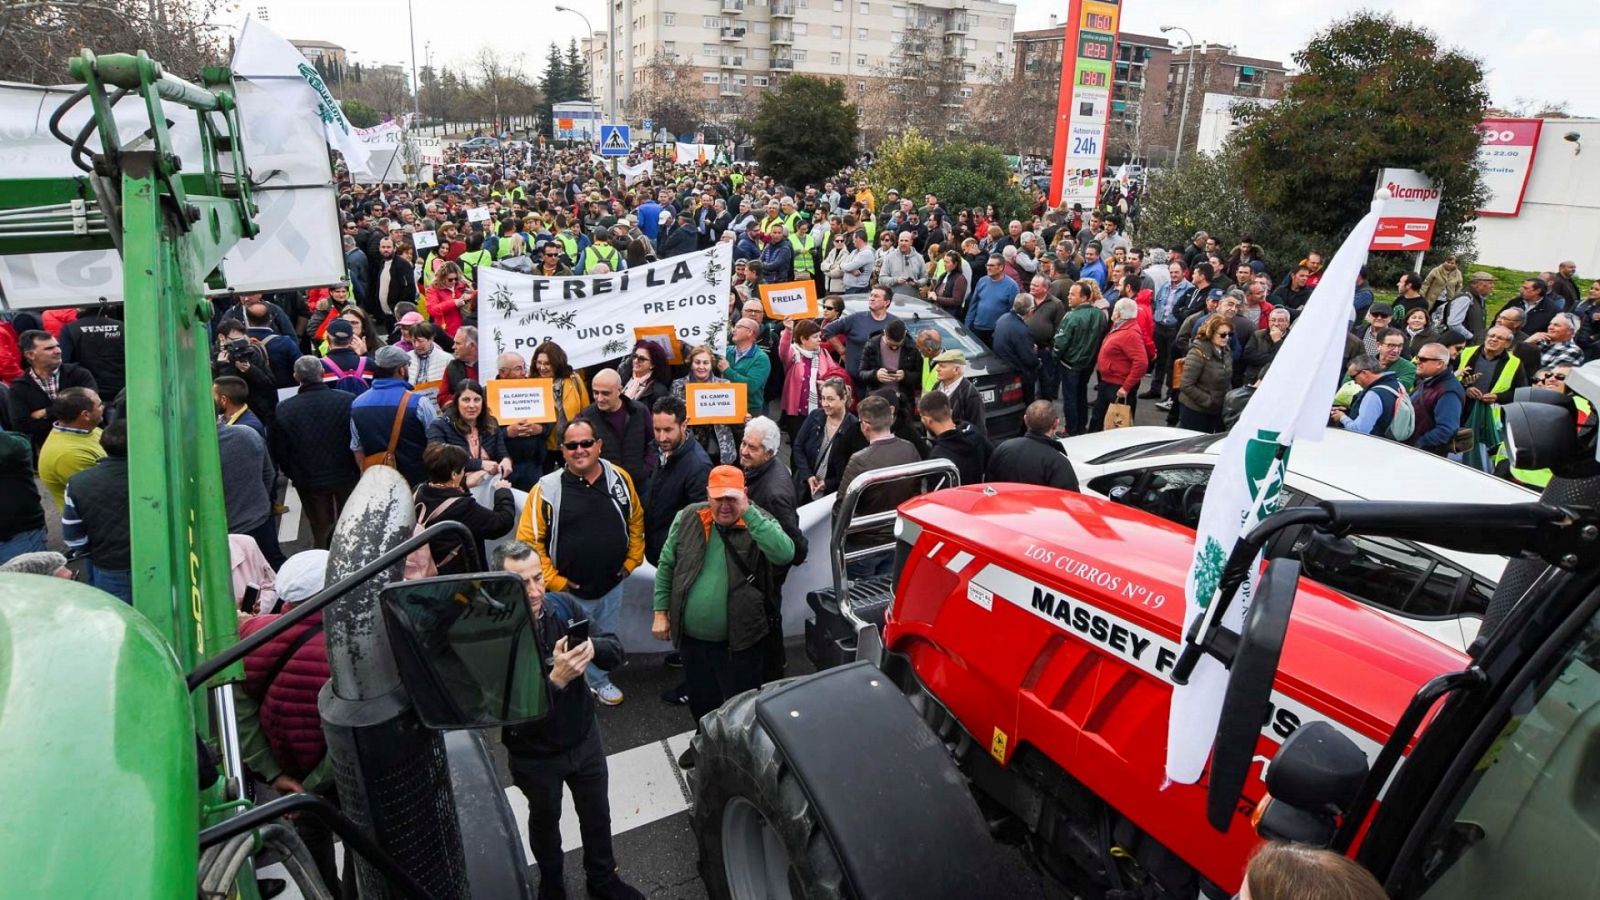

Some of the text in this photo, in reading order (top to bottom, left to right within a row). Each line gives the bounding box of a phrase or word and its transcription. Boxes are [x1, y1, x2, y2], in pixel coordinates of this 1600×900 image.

[1073, 137, 1096, 154] 24h
[1387, 182, 1438, 201] Alcampo
[643, 294, 717, 314] PRECIOS
[772, 293, 803, 303] FREILA
[80, 324, 119, 333] FENDT
[576, 323, 626, 340] UNOS
[1024, 544, 1055, 564] LOS
[1055, 556, 1121, 591] CURROS
[1031, 586, 1151, 661] MASSEY
